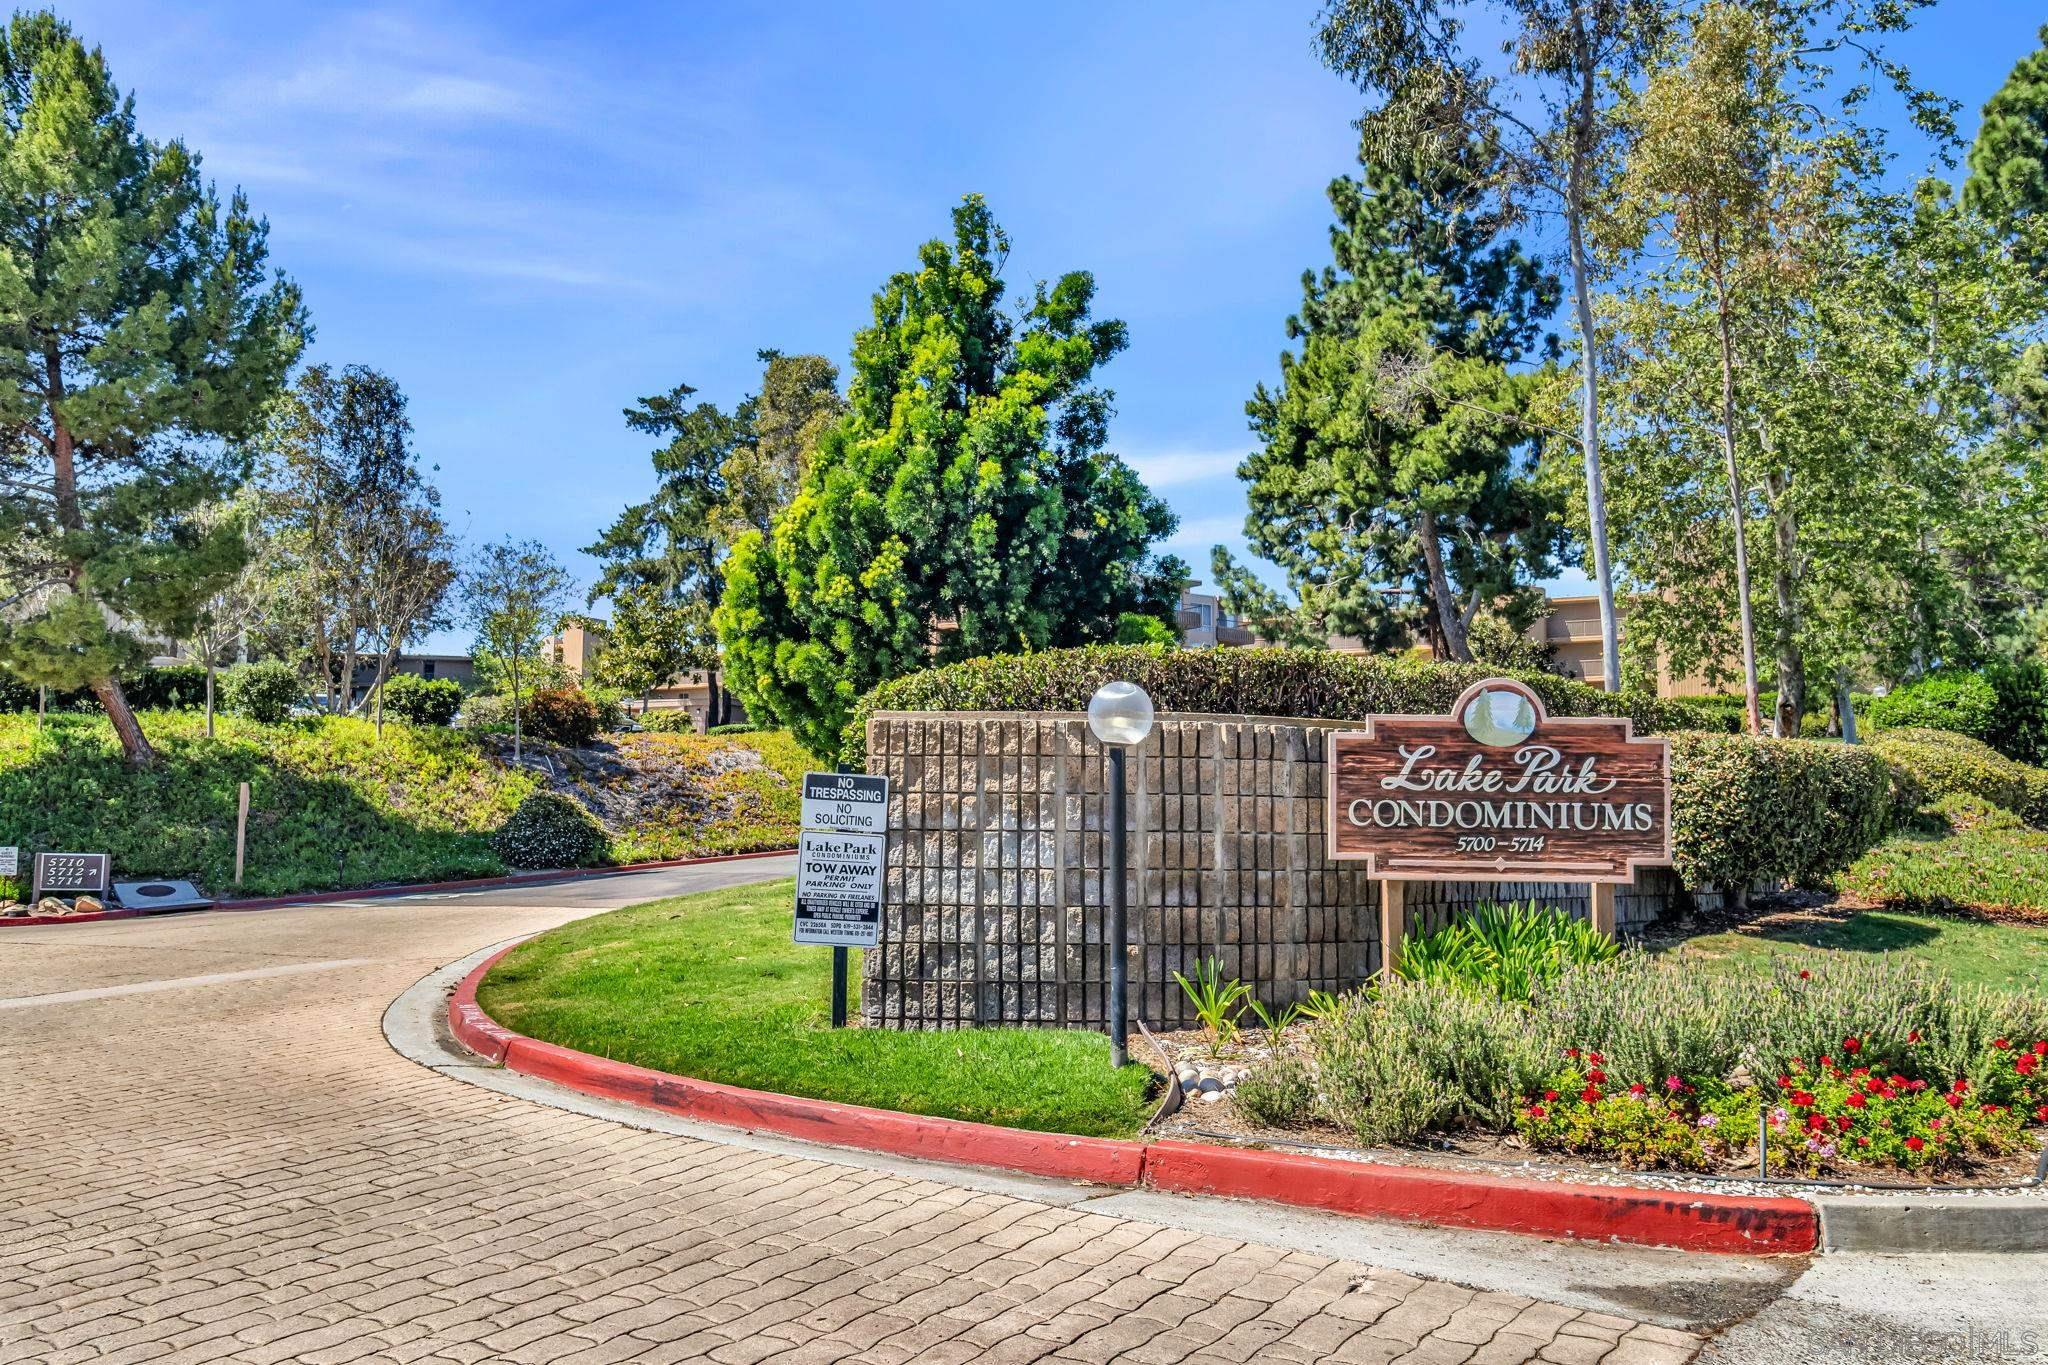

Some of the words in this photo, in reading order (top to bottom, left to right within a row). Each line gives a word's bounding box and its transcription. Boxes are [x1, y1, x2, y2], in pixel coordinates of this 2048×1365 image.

[1381, 744, 1503, 792] Lake
[1506, 745, 1617, 794] Park
[838, 777, 854, 789] NO
[810, 787, 881, 801] TRESPASSING
[836, 803, 852, 814] NO
[815, 814, 872, 826] SOLICITING
[1349, 798, 1653, 832] CONDOMINIUMS
[806, 841, 840, 852] Lake
[842, 843, 876, 854] Park
[812, 852, 870, 860] CONDOMINIUMS
[48, 858, 85, 867] 5710
[47, 867, 84, 876] 5712
[806, 862, 837, 874] TOW
[839, 864, 877, 876] AWAY
[46, 877, 83, 885] 5714
[824, 874, 856, 882] PERMIT
[805, 880, 846, 889] PARKING
